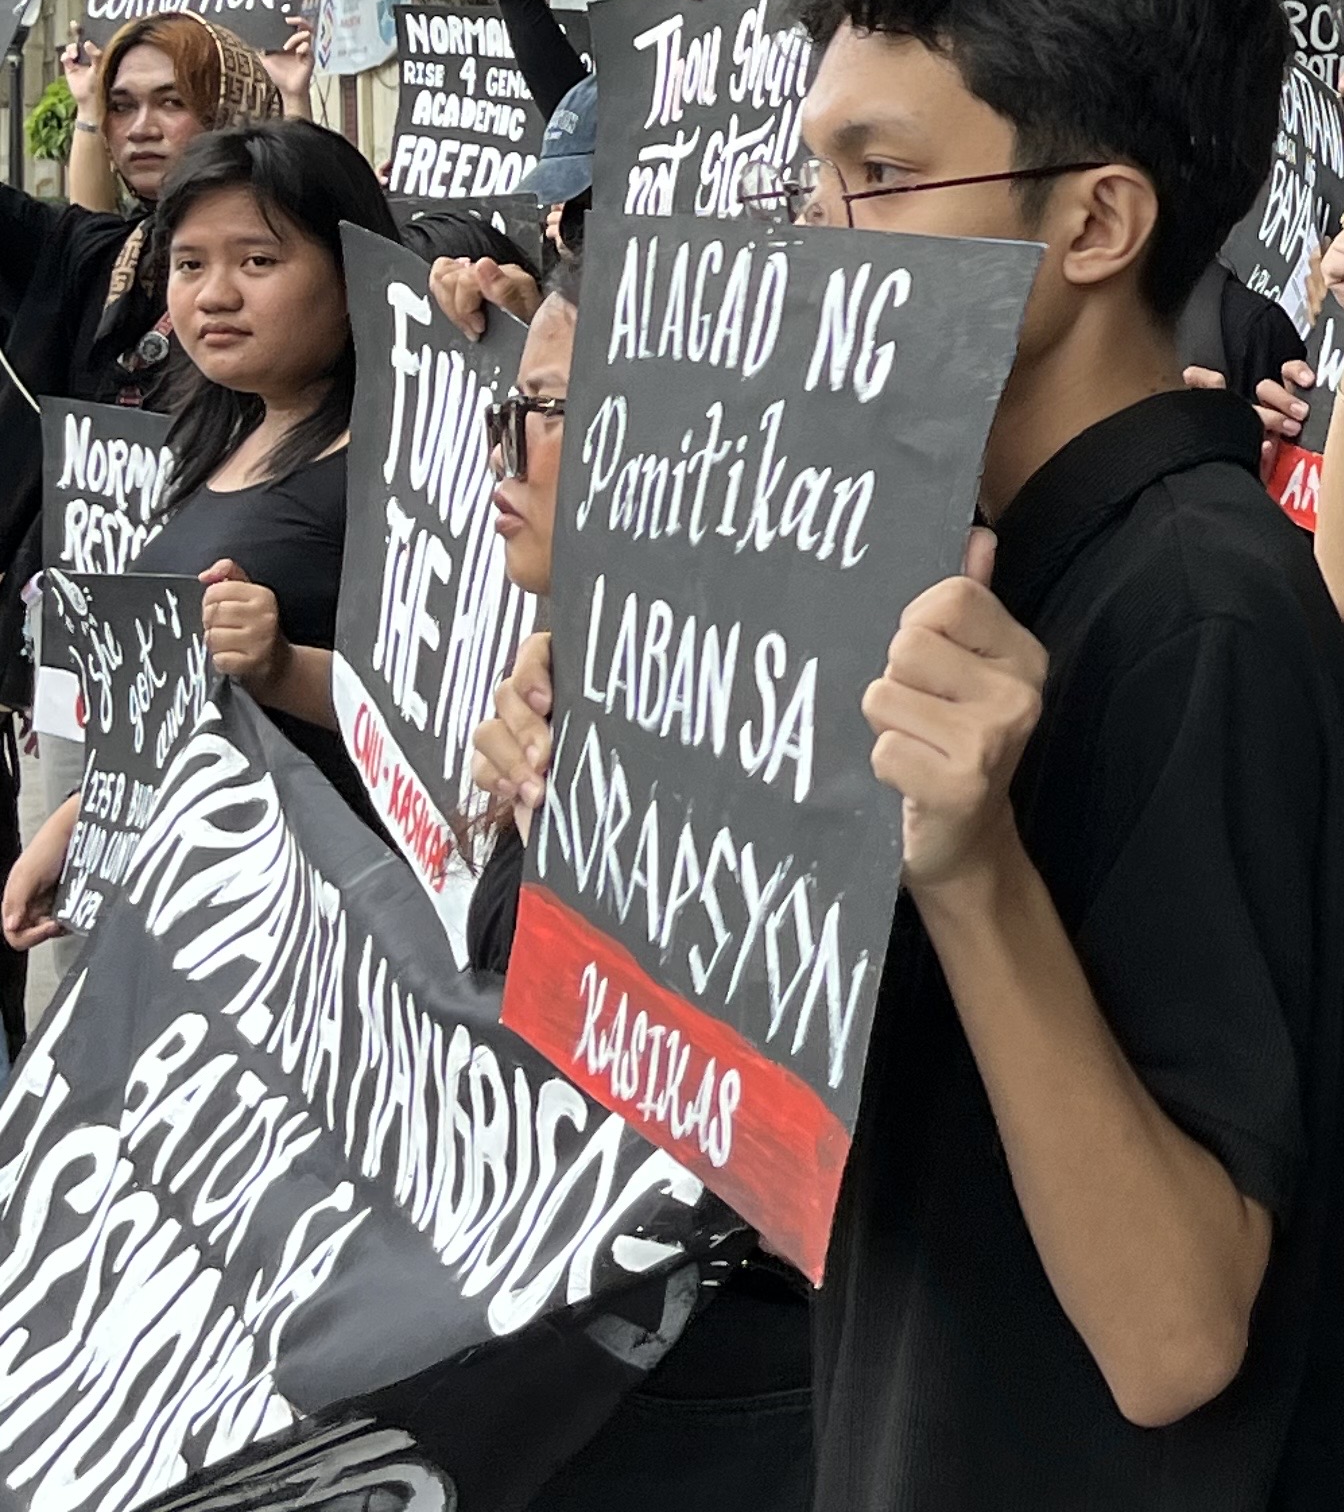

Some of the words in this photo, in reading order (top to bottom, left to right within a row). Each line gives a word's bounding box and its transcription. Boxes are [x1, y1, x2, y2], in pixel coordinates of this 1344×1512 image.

[403, 60, 445, 88] RISE
[459, 56, 477, 96] 4
[485, 67, 534, 100] GENU
[405, 13, 516, 58] NORMAL
[412, 90, 527, 142] ACADEMIC
[633, 13, 722, 130] Thou
[607, 235, 790, 381] ALAGAD
[804, 262, 912, 403] NG
[576, 395, 877, 569] Panitikan
[583, 573, 742, 759] LABAN
[738, 630, 819, 804] SA
[536, 710, 872, 1089] KORAPSYON
[121, 1011, 323, 1267] BATOK
[572, 961, 742, 1169] KASIKAS
